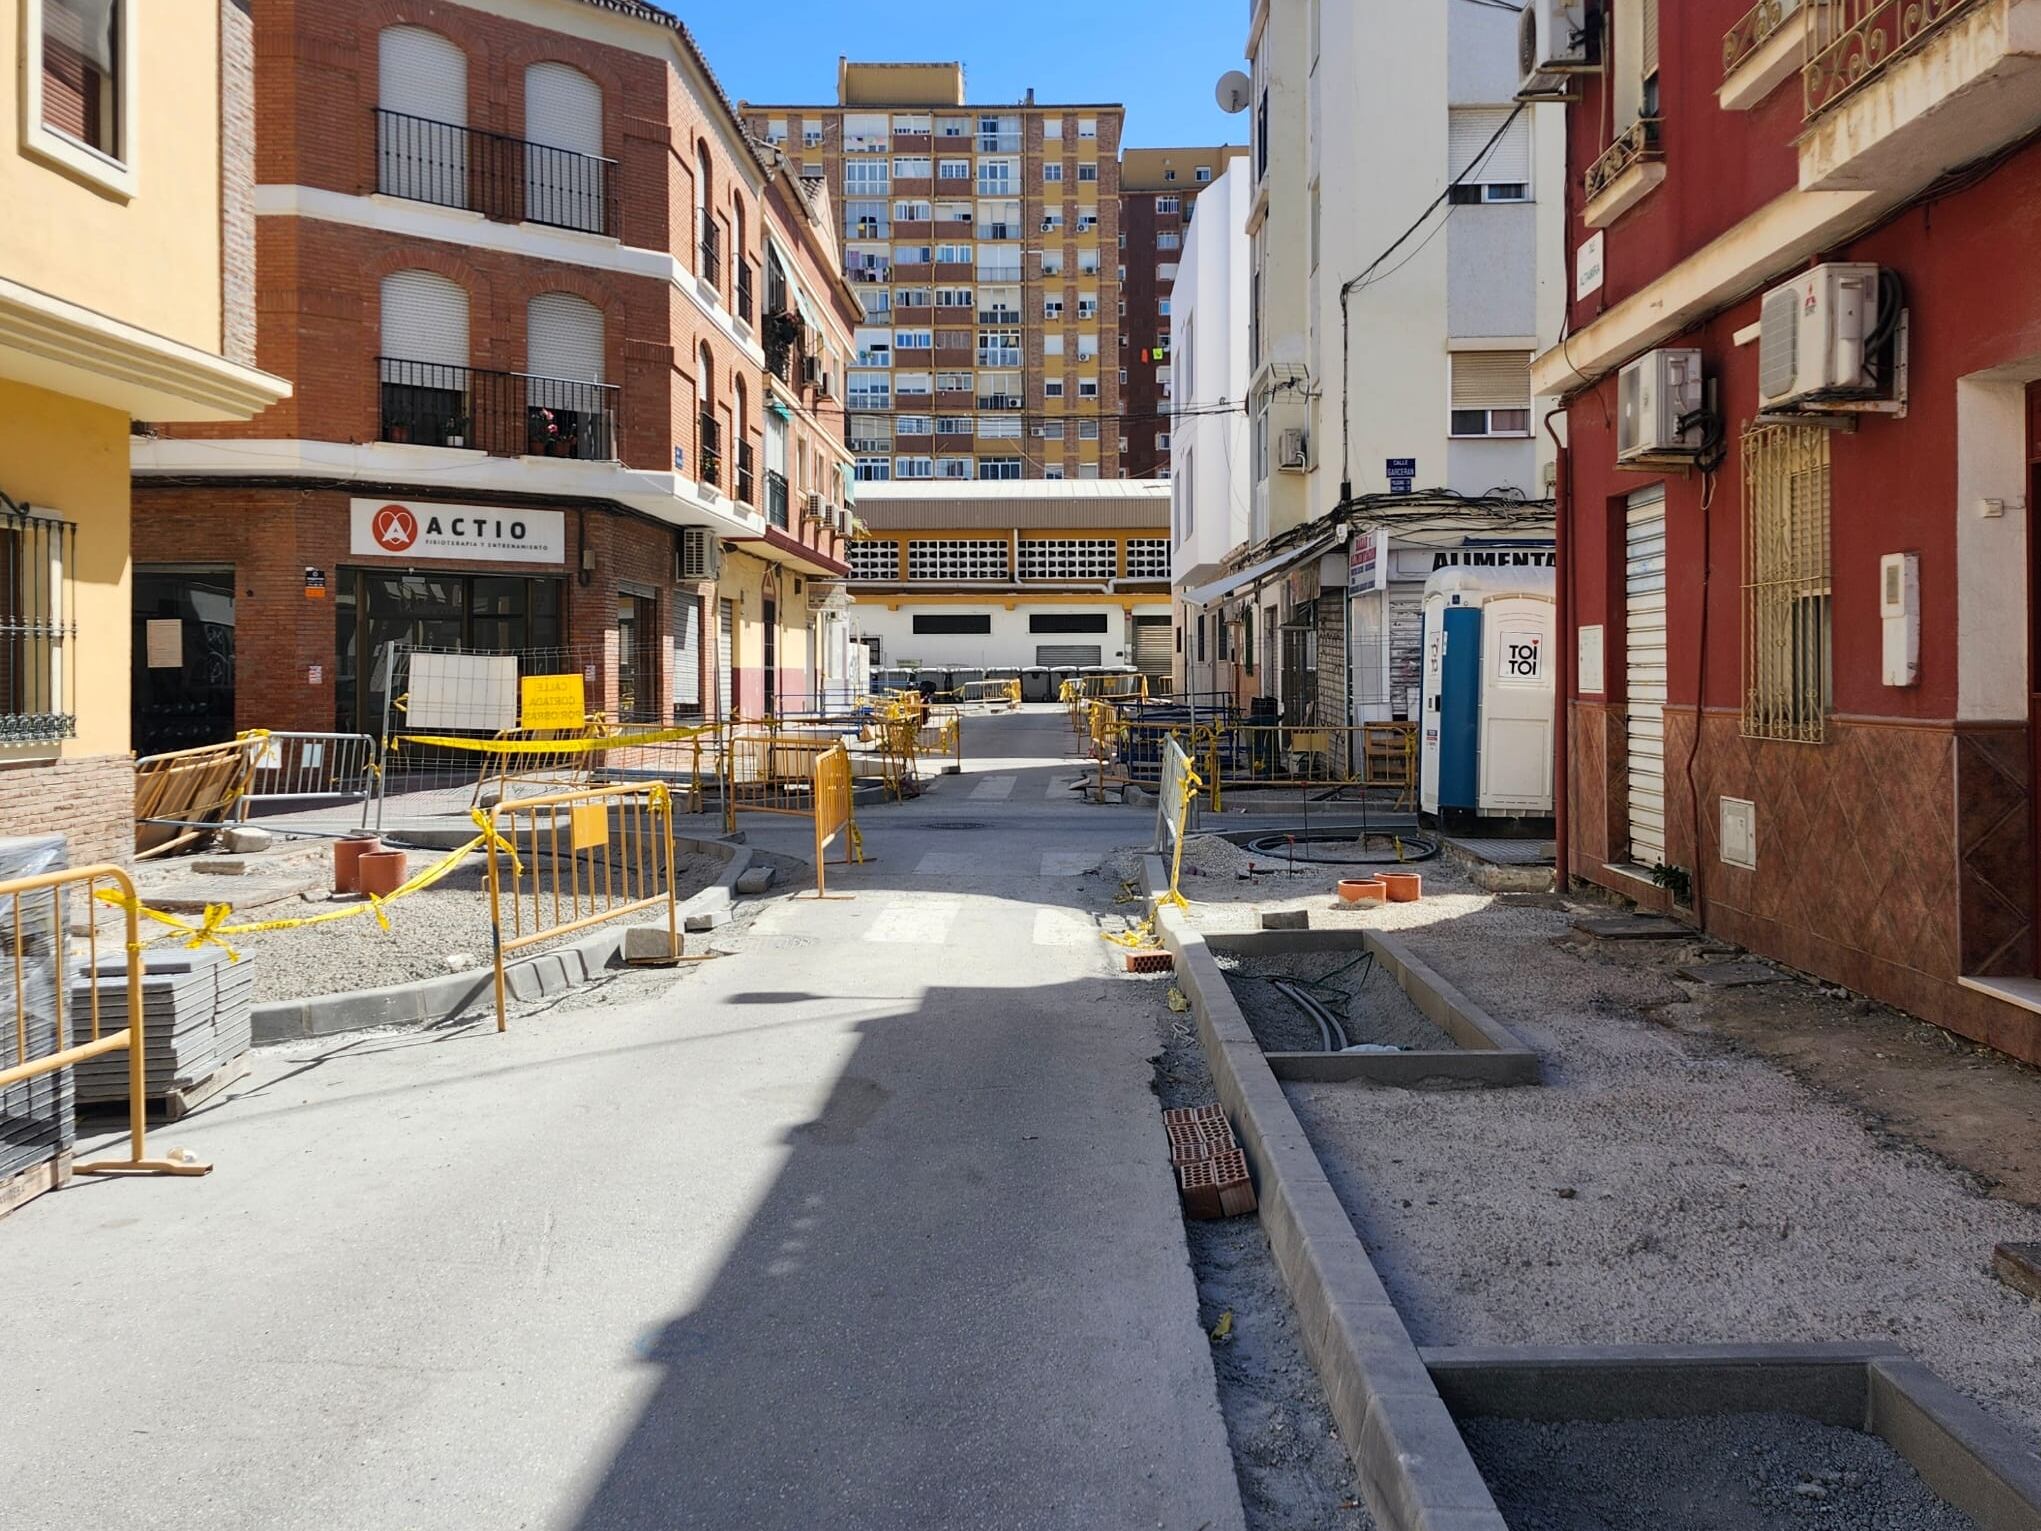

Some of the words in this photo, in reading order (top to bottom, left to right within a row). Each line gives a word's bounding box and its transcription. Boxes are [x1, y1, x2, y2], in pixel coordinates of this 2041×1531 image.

[426, 516, 526, 539] ACTIO
[425, 539, 477, 547] FISIOTERAPIA
[488, 542, 548, 551] ENTRENAMIENTO
[1509, 645, 1537, 660] TOI
[1508, 660, 1536, 675] TOI
